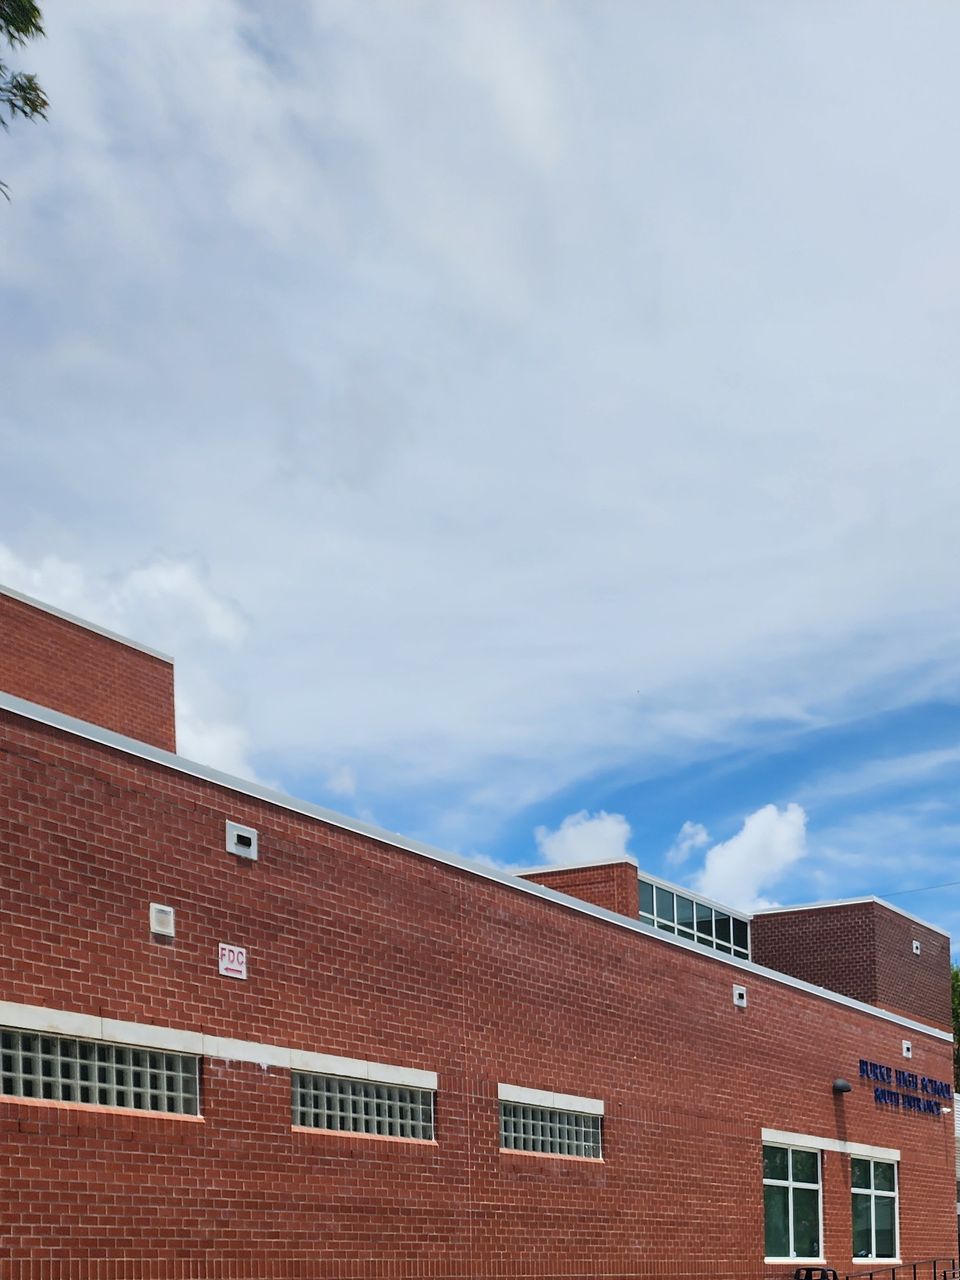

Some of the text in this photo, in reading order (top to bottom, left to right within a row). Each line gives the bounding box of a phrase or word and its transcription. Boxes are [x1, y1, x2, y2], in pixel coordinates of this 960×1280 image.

[220, 947, 244, 965] FDC
[859, 1059, 953, 1101] BURKE HIGH SCHOOL
